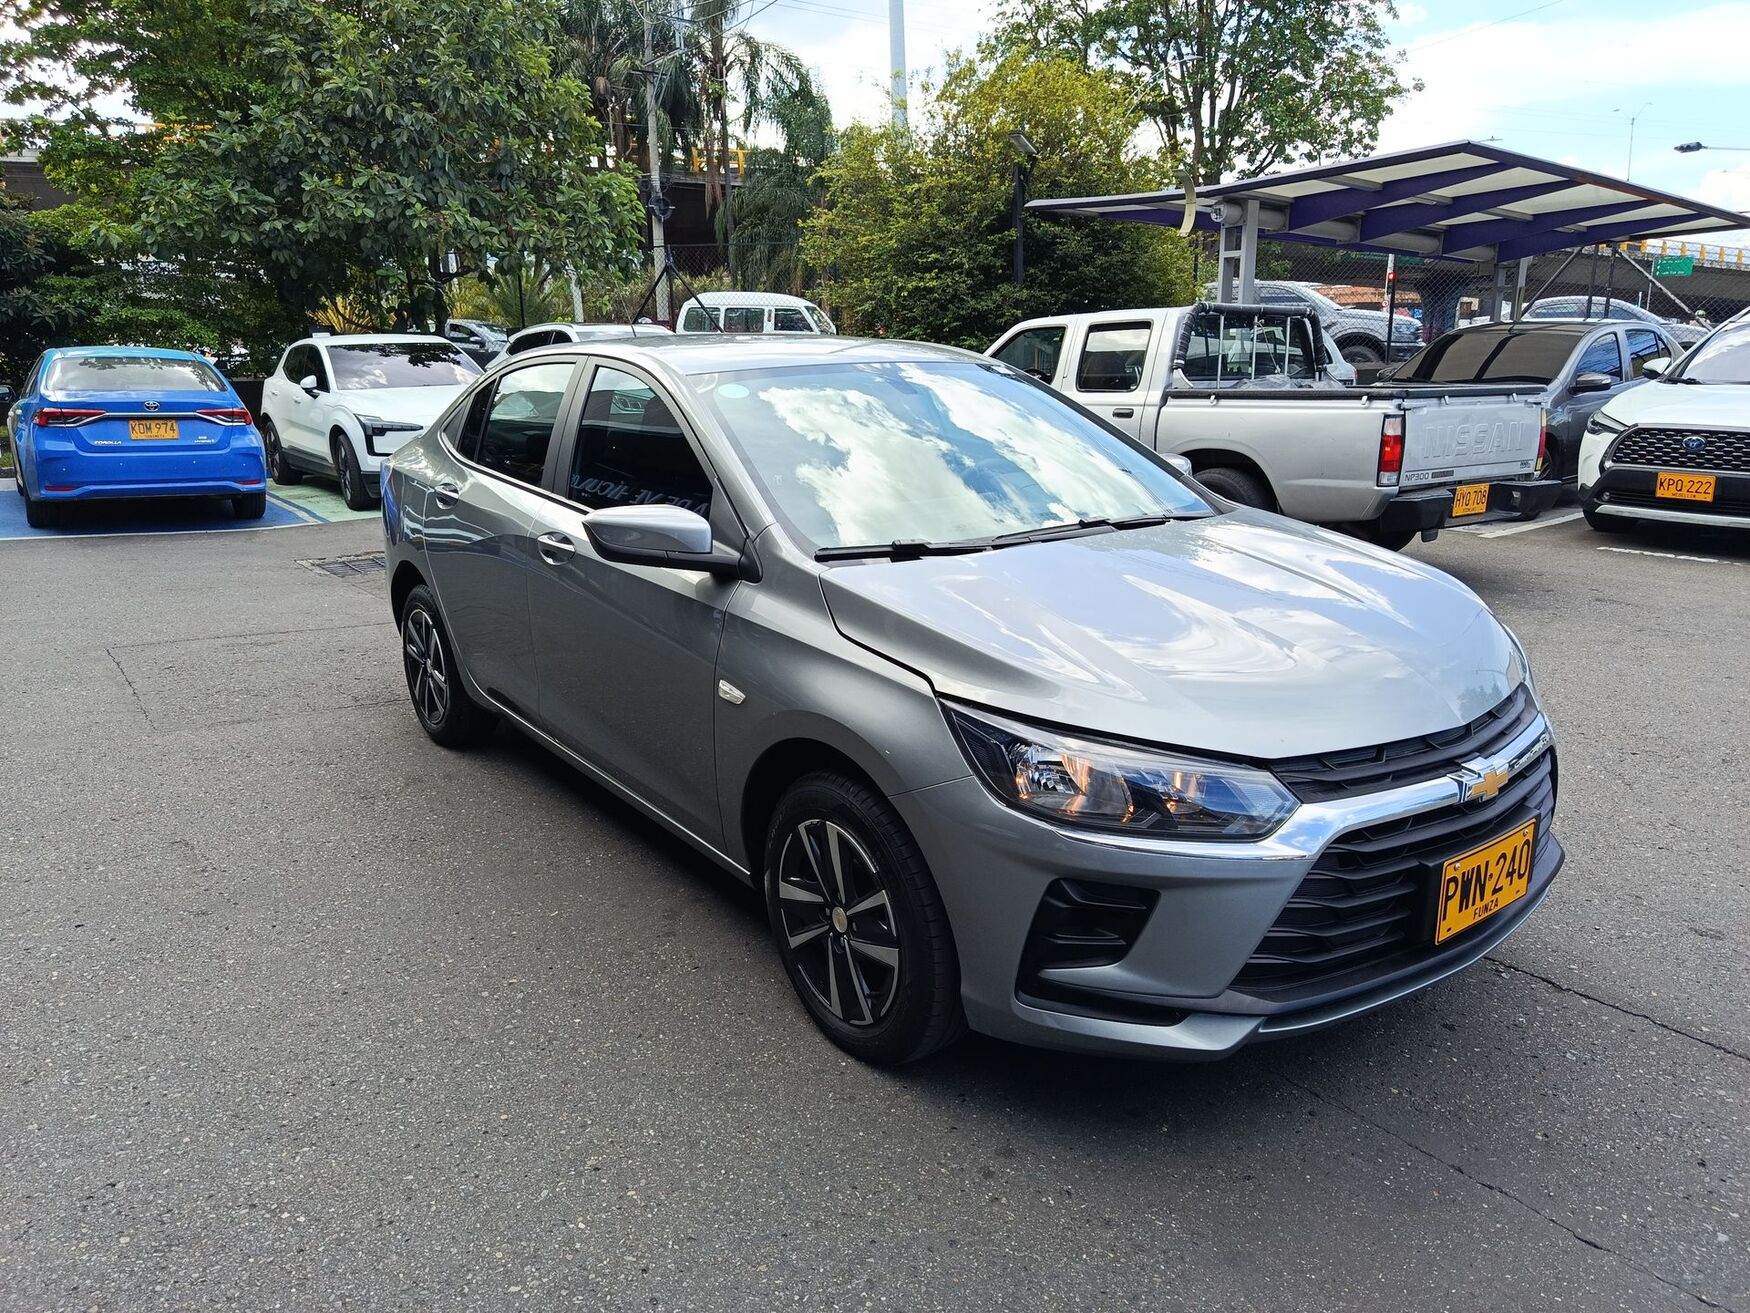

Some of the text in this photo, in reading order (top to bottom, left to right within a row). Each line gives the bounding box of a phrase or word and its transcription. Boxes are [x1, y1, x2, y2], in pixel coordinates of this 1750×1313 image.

[130, 422, 176, 435] KOM 974
[1423, 421, 1526, 459] NISSAN
[1404, 472, 1430, 481] NP300
[1658, 477, 1713, 495] KPQ 222
[1472, 489, 1487, 506] 708
[1473, 897, 1499, 921] FUNZA
